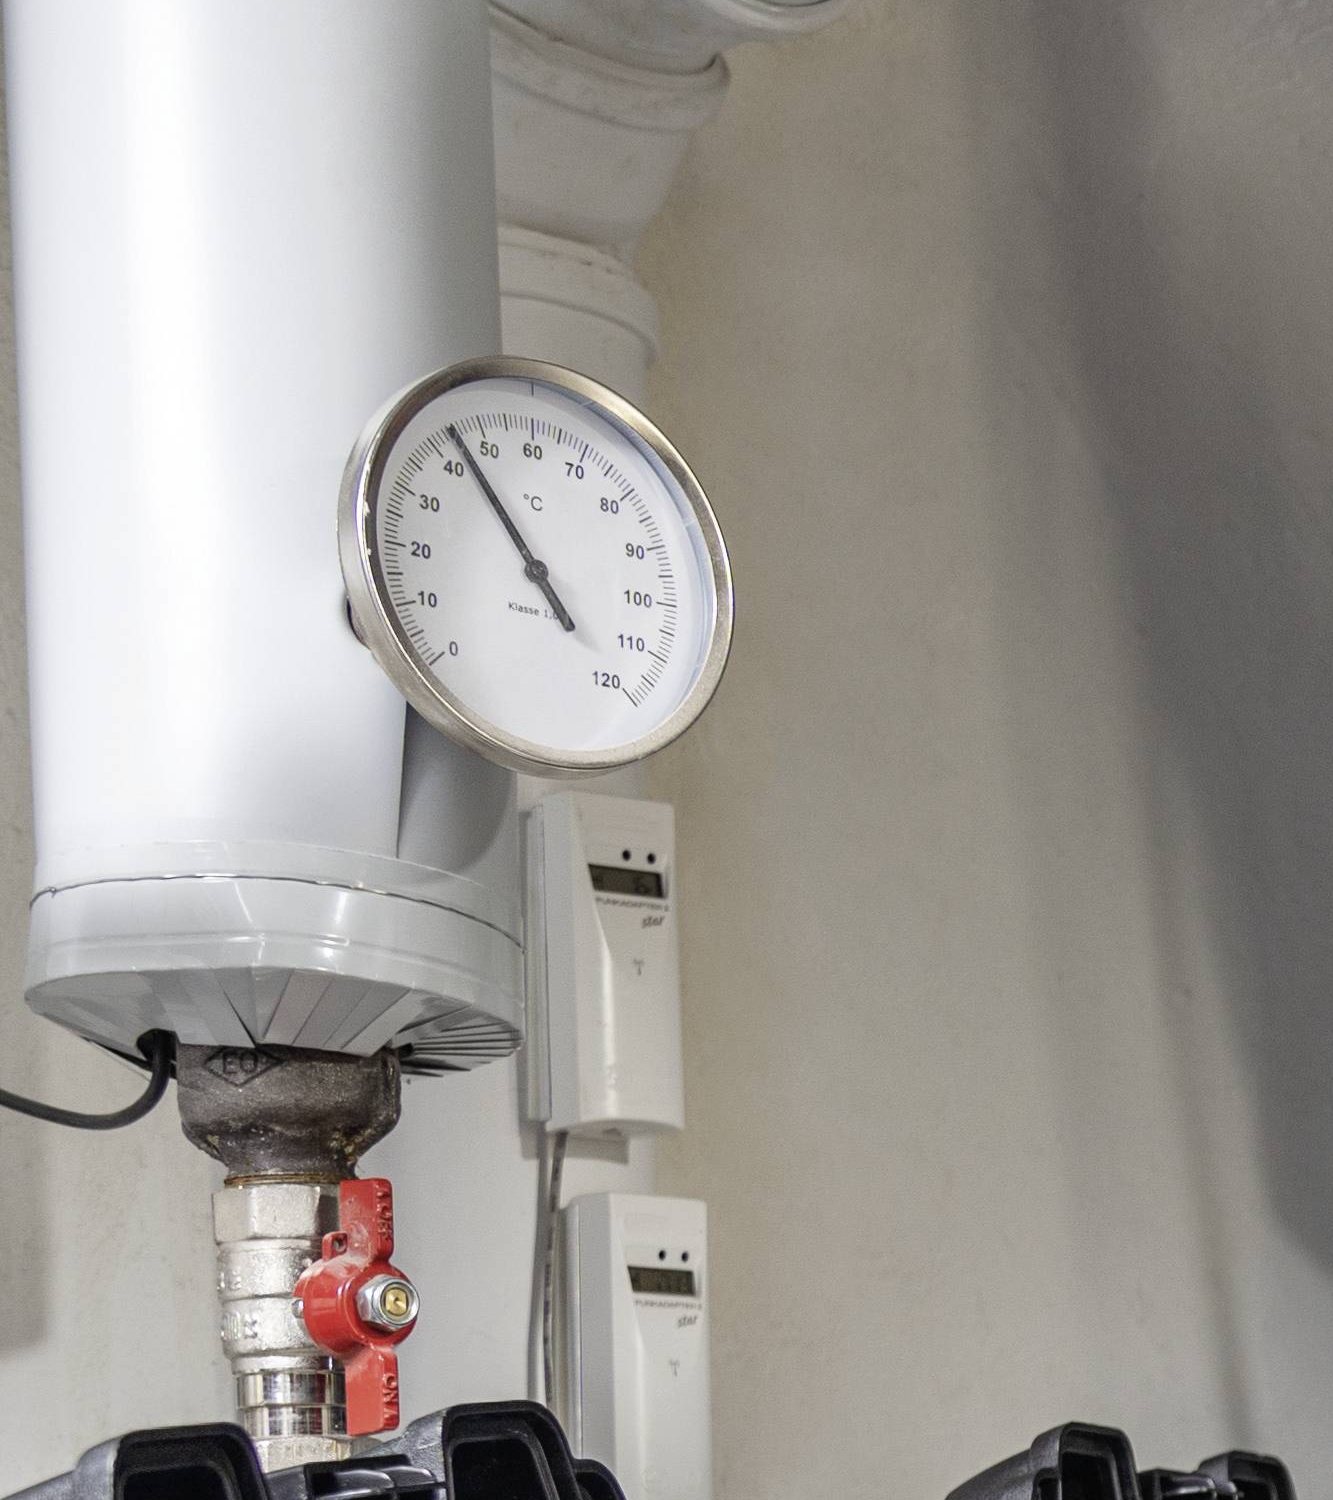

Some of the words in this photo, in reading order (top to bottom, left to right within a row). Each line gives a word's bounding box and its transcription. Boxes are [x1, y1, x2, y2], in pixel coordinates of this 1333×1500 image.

[481, 441, 499, 458] 50
[523, 443, 542, 459] 60
[444, 459, 464, 476] 40
[565, 461, 584, 479] 70
[420, 493, 440, 512] 30
[523, 492, 543, 511] °C
[600, 497, 619, 513] 80
[411, 541, 431, 558] 20
[626, 541, 645, 559] 90
[418, 590, 437, 607] 10
[624, 589, 652, 607] 100
[508, 600, 539, 616] Klasse
[449, 639, 458, 656] 0
[617, 633, 645, 651] 110
[592, 669, 620, 688] 120
